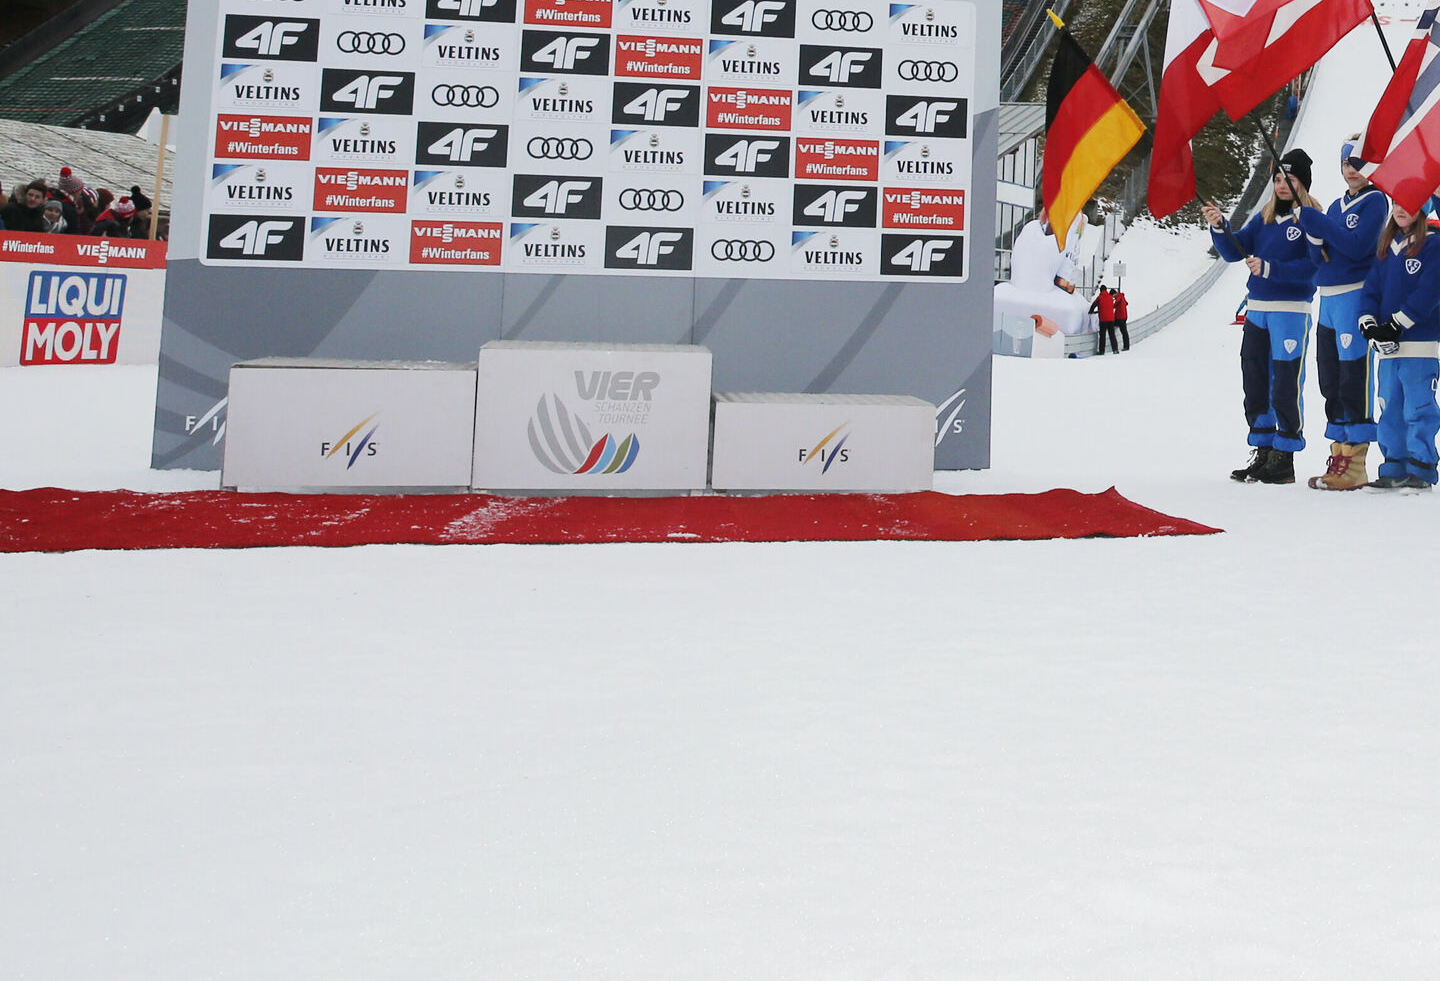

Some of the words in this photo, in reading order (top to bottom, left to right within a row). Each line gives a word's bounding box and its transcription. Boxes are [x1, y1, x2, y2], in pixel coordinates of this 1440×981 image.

[535, 8, 601, 23] #Winterfans
[632, 7, 691, 23] VELTINS
[721, 0, 786, 32] 4F
[235, 21, 309, 56] 4F
[902, 23, 958, 38] VELTINS
[438, 45, 500, 61] VELTINS
[531, 36, 600, 70] 4F
[618, 38, 700, 58] VIESSMANN
[626, 60, 691, 75] #Winterfans
[722, 59, 780, 75] VELTINS
[809, 50, 873, 83] 4F
[235, 85, 300, 101] VELTINS
[332, 75, 404, 109] 4F
[710, 90, 790, 109] VIESSMANN
[532, 98, 593, 113] VELTINS
[623, 88, 690, 122] 4F
[717, 112, 781, 126] #Winterfans
[810, 110, 868, 125] VELTINS
[895, 101, 958, 133] 4F
[219, 118, 310, 138] VIESSMANN
[227, 141, 299, 155] #Winterfans
[332, 138, 396, 154] VELTINS
[427, 127, 498, 162] 4F
[798, 141, 877, 160] VIESSMANN
[624, 150, 684, 165] VELTINS
[714, 139, 780, 173] 4F
[805, 163, 868, 176] #Winterfans
[897, 160, 953, 175] VELTINS
[317, 171, 406, 191] VIESSMANN
[227, 185, 293, 201] VELTINS
[325, 194, 395, 208] #Winterfans
[428, 191, 490, 206] VELTINS
[523, 180, 592, 214] 4F
[885, 191, 962, 209] VIESSMANN
[716, 201, 775, 216] VELTINS
[803, 189, 868, 223] 4F
[892, 212, 954, 225] #Winterfans
[219, 220, 294, 255] 4F
[413, 223, 500, 243] VIESSMANN
[2, 240, 55, 254] #Winterfans
[77, 240, 147, 264] VIESSMANN
[325, 238, 390, 253] VELTINS
[421, 247, 490, 260] #Winterfans
[524, 243, 586, 258] VELTINS
[615, 231, 683, 265] 4F
[805, 251, 863, 265] VELTINS
[890, 239, 954, 272] 4F
[30, 275, 123, 318] LIQUI
[25, 321, 119, 361] MOLY
[574, 370, 661, 401] VIER
[593, 401, 652, 413] SCHANZEN
[599, 413, 649, 425] TOURNEE
